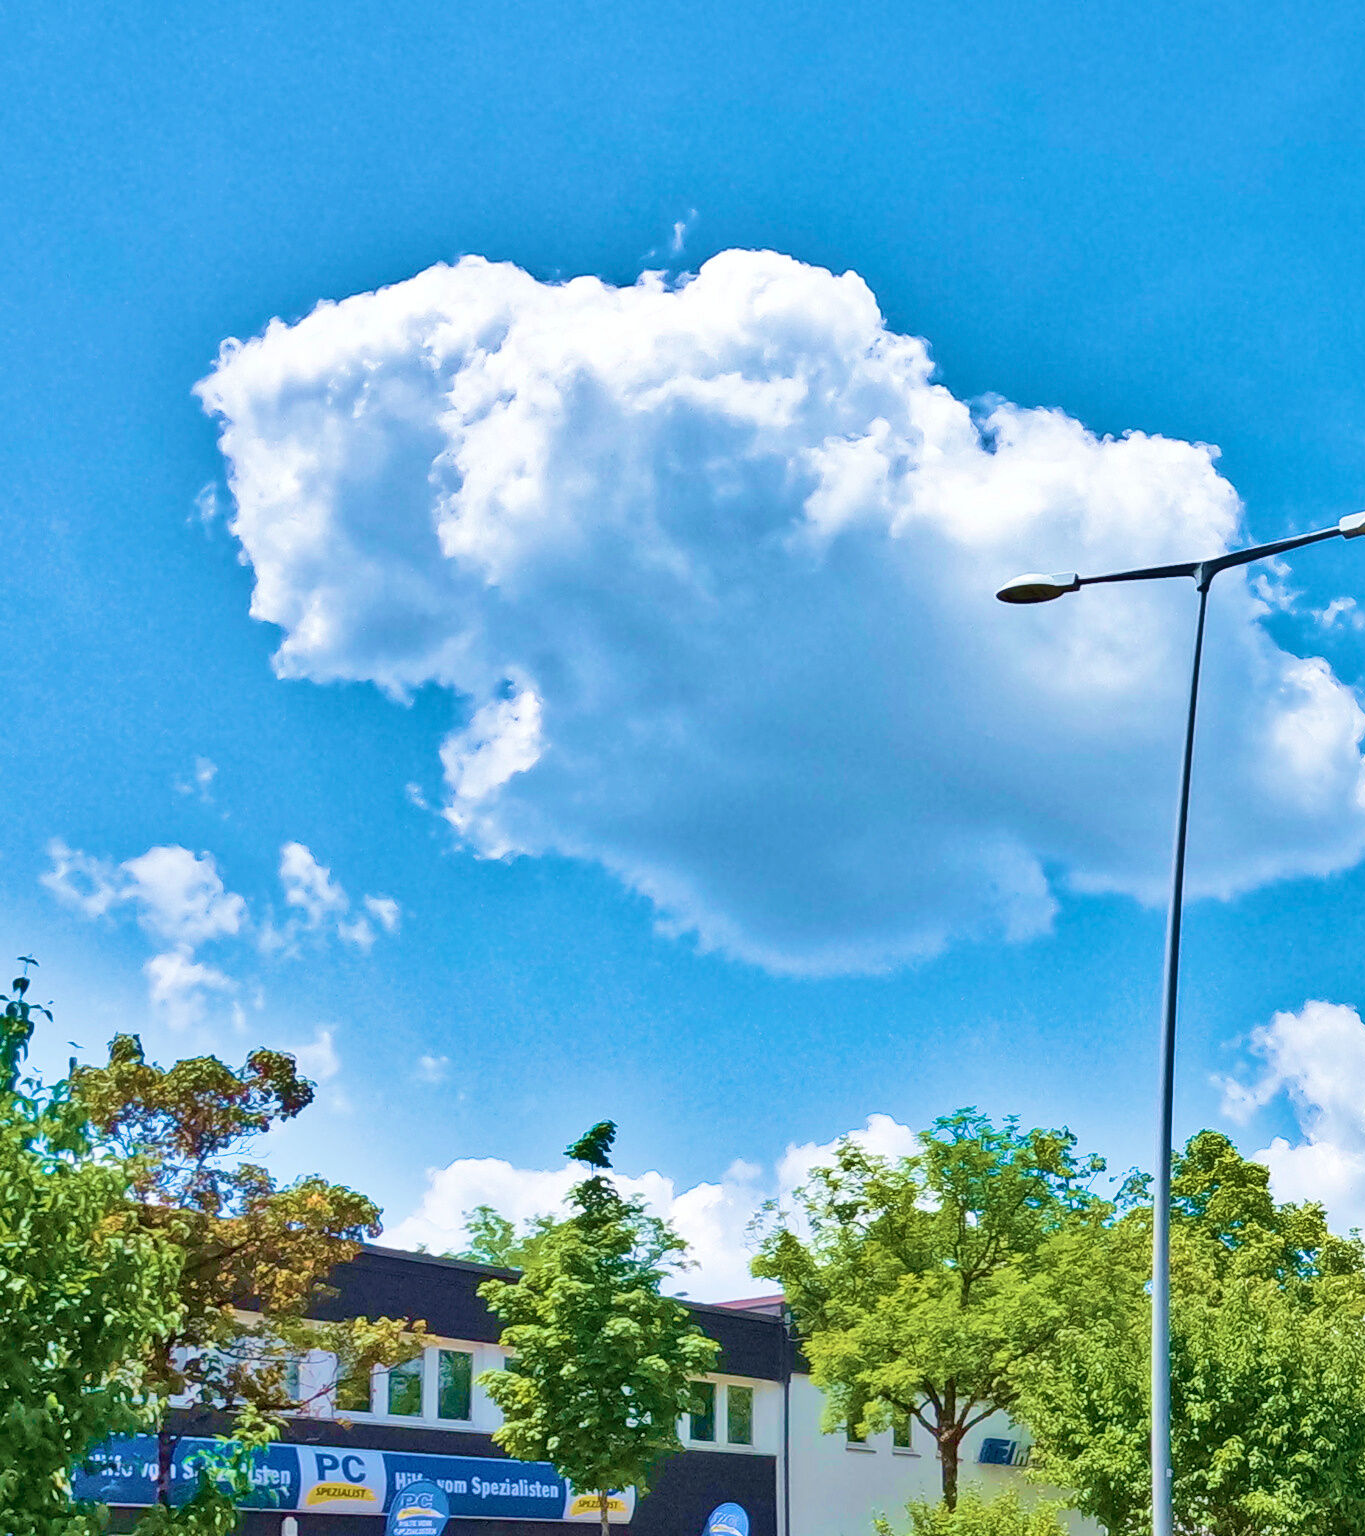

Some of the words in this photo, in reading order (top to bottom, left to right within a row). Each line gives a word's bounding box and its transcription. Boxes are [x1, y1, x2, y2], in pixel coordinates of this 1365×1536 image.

[315, 1453, 366, 1483] PC
[316, 1487, 366, 1498] SPEZIALIST
[472, 1477, 559, 1498] Spezialisten
